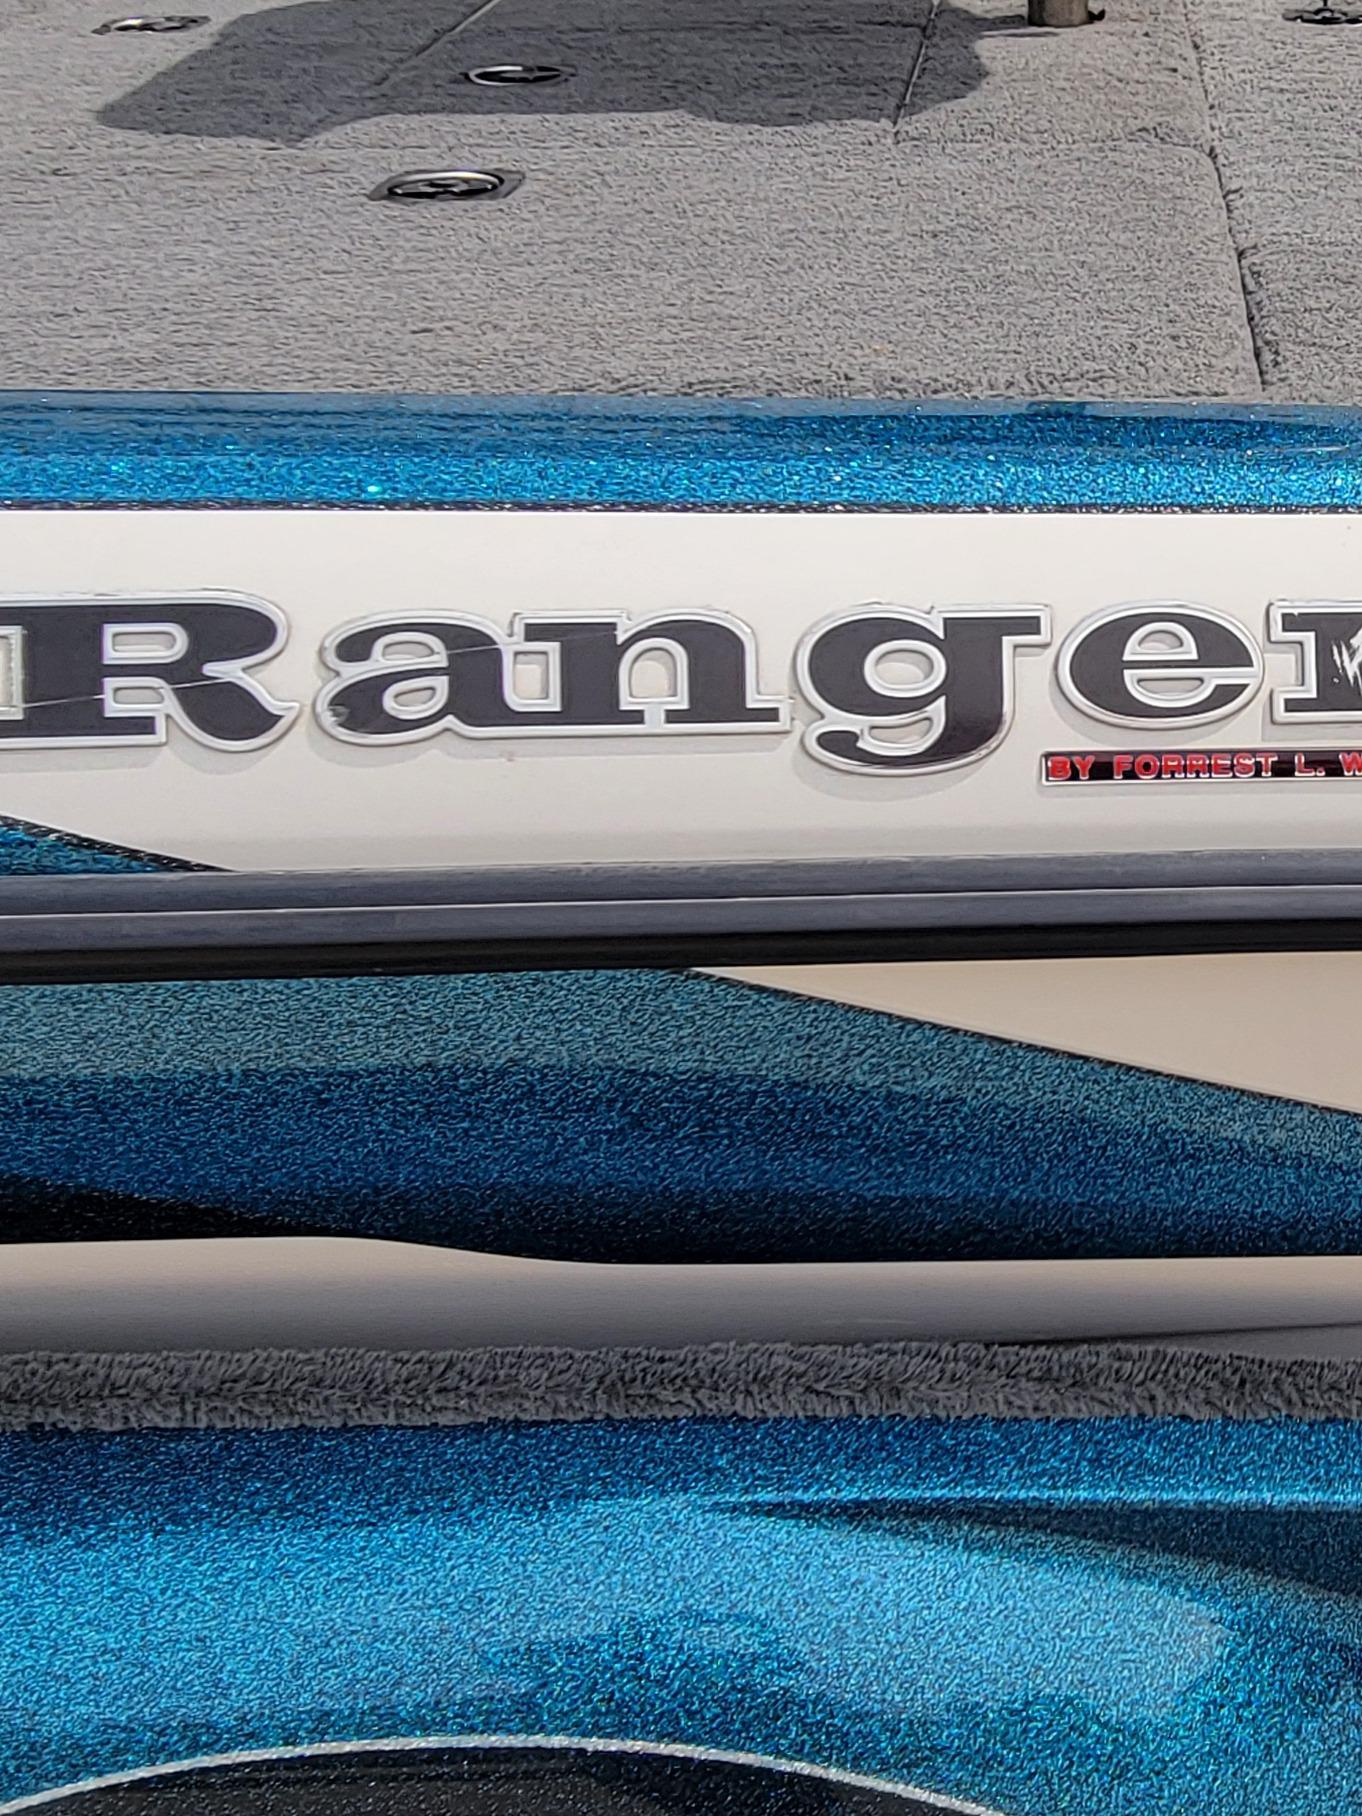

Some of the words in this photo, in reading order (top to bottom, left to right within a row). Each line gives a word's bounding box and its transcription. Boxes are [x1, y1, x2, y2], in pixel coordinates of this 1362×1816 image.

[1047, 755, 1095, 781] BY
[1112, 752, 1279, 778] FORREST
[1294, 752, 1326, 777] L.
